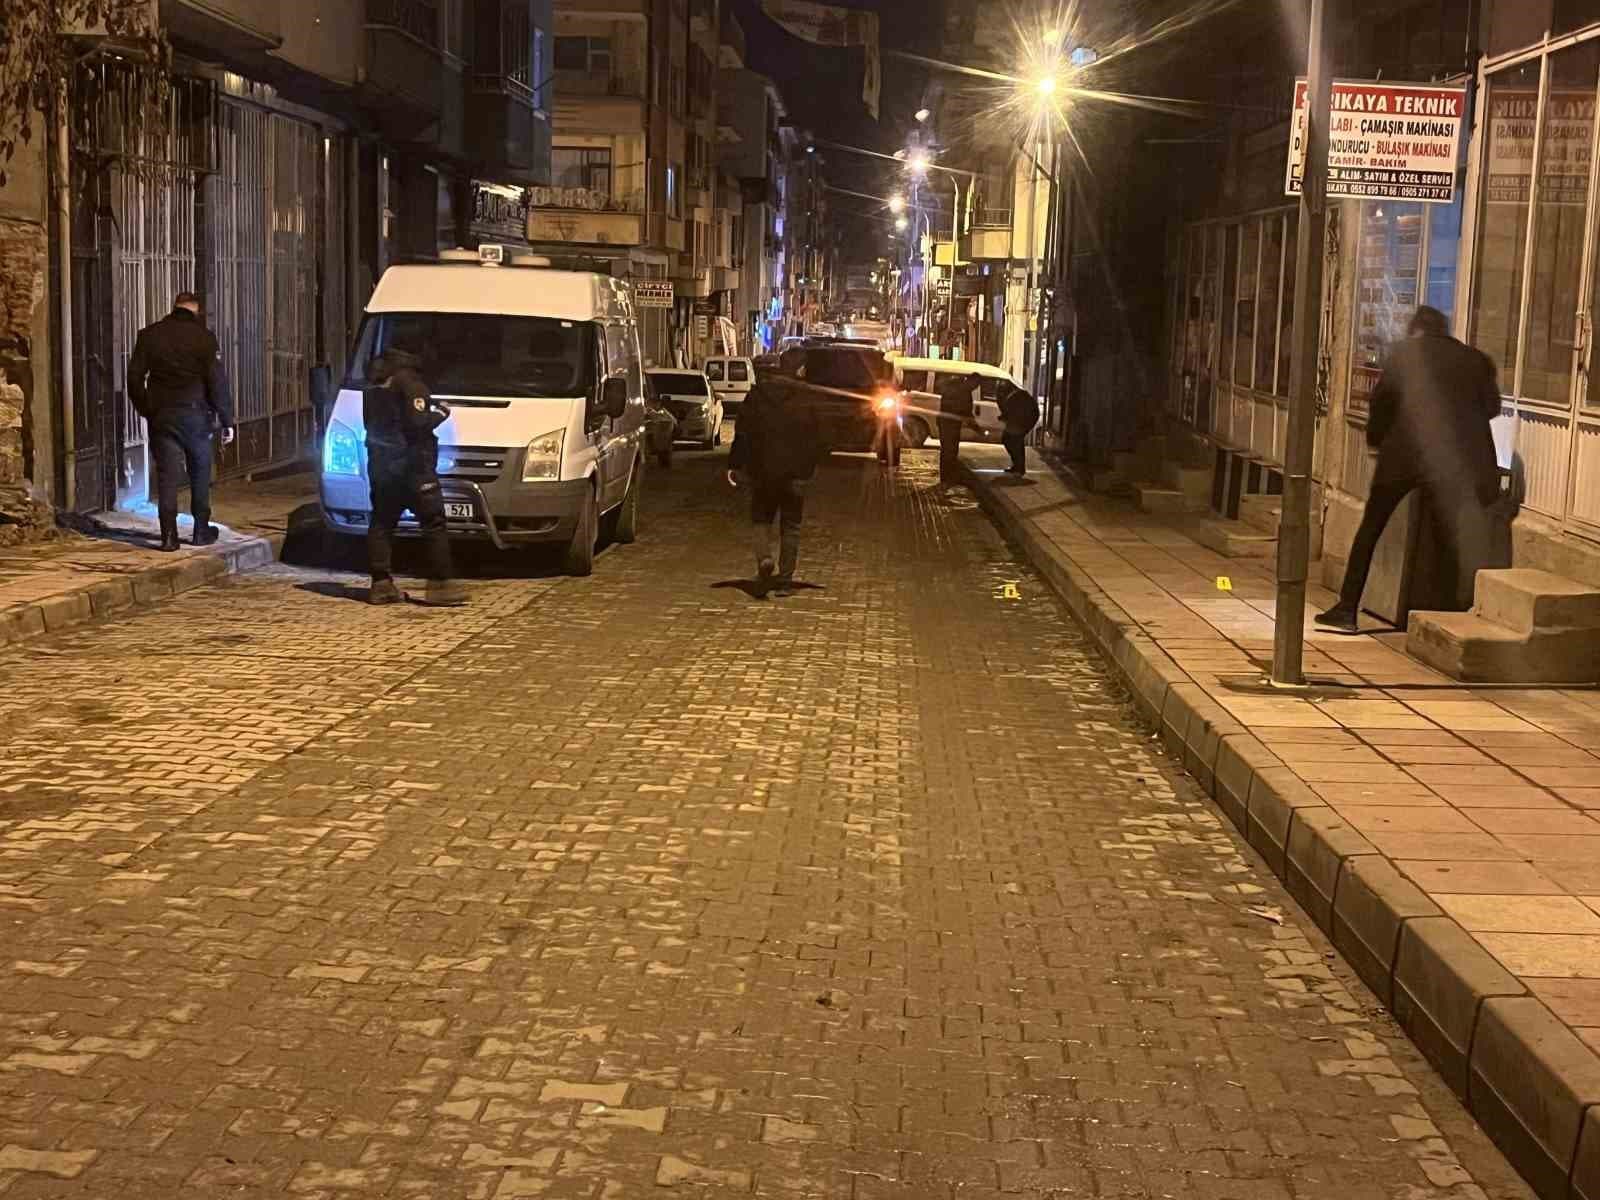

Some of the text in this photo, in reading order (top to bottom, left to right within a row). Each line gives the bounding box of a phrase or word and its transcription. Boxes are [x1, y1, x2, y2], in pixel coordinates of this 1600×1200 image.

[1395, 93, 1457, 115] TEKNİK
[1360, 118, 1404, 138] ÇAMAŞIR
[1406, 120, 1454, 137] MAKİNASI
[1376, 141, 1411, 158] BULAŞIK
[1412, 141, 1451, 158] MAKİNASI
[1369, 158, 1407, 168] BAKIM
[1364, 171, 1389, 182] SATIM
[1399, 172, 1420, 183] ÖZEL
[1421, 174, 1451, 185] SERVİS
[451, 504, 471, 517] 521
